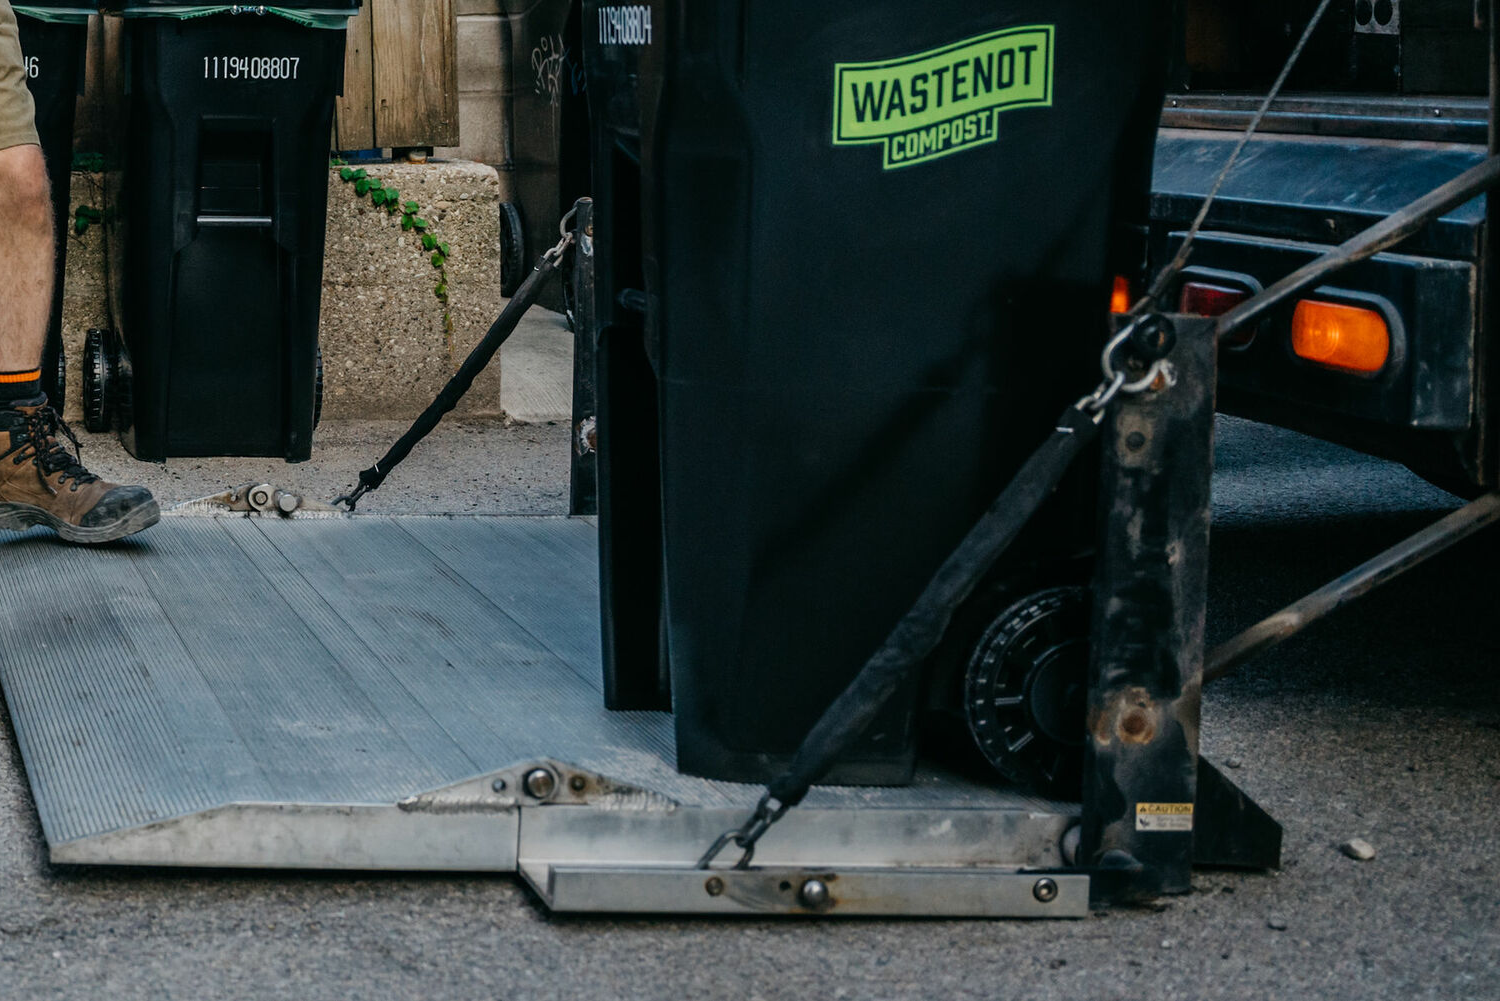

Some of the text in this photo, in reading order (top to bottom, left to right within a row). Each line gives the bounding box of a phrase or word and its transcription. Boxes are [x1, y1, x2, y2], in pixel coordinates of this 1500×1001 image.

[598, 5, 652, 45] 1119408804
[203, 56, 300, 79] 1119408807
[851, 45, 1038, 123] WASTENOT
[1148, 804, 1191, 813] CAUTION
